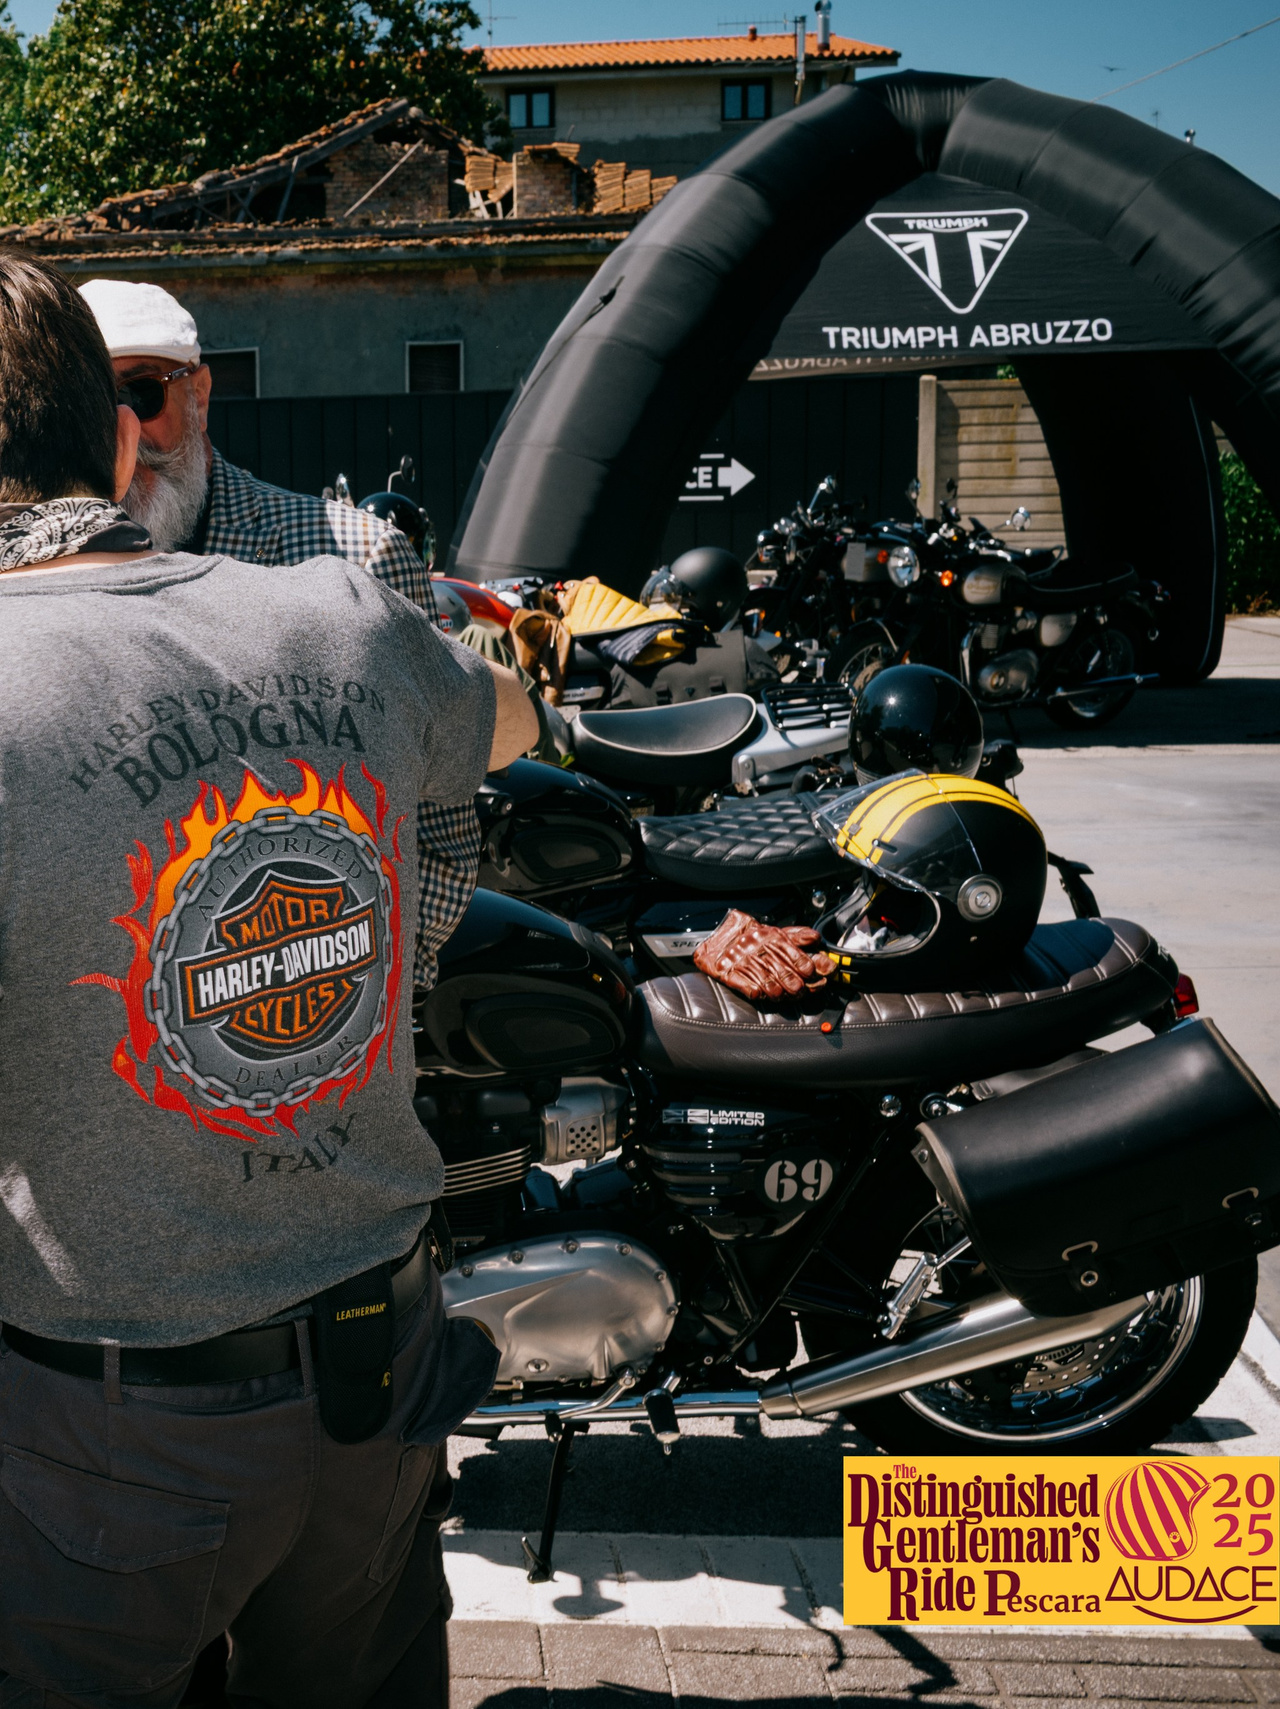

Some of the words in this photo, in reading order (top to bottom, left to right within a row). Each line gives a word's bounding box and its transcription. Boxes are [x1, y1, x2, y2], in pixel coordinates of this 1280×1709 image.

[904, 217, 988, 229] TRIUMPH
[822, 326, 958, 349] TRIUMPH
[969, 318, 1113, 347] ABRUZZO
[113, 700, 368, 808] BOLOGNA
[198, 837, 363, 921] AUTHORIZED
[240, 893, 330, 946] MOTOR
[197, 919, 371, 1008] HARLEY-DAVIDSON
[244, 982, 337, 1036] CYCLES
[234, 1035, 354, 1087] DEALER
[710, 1110, 765, 1120] LIMITED
[710, 1118, 765, 1127] EDITION
[241, 1112, 358, 1183] ITALY
[764, 1159, 833, 1203] 69
